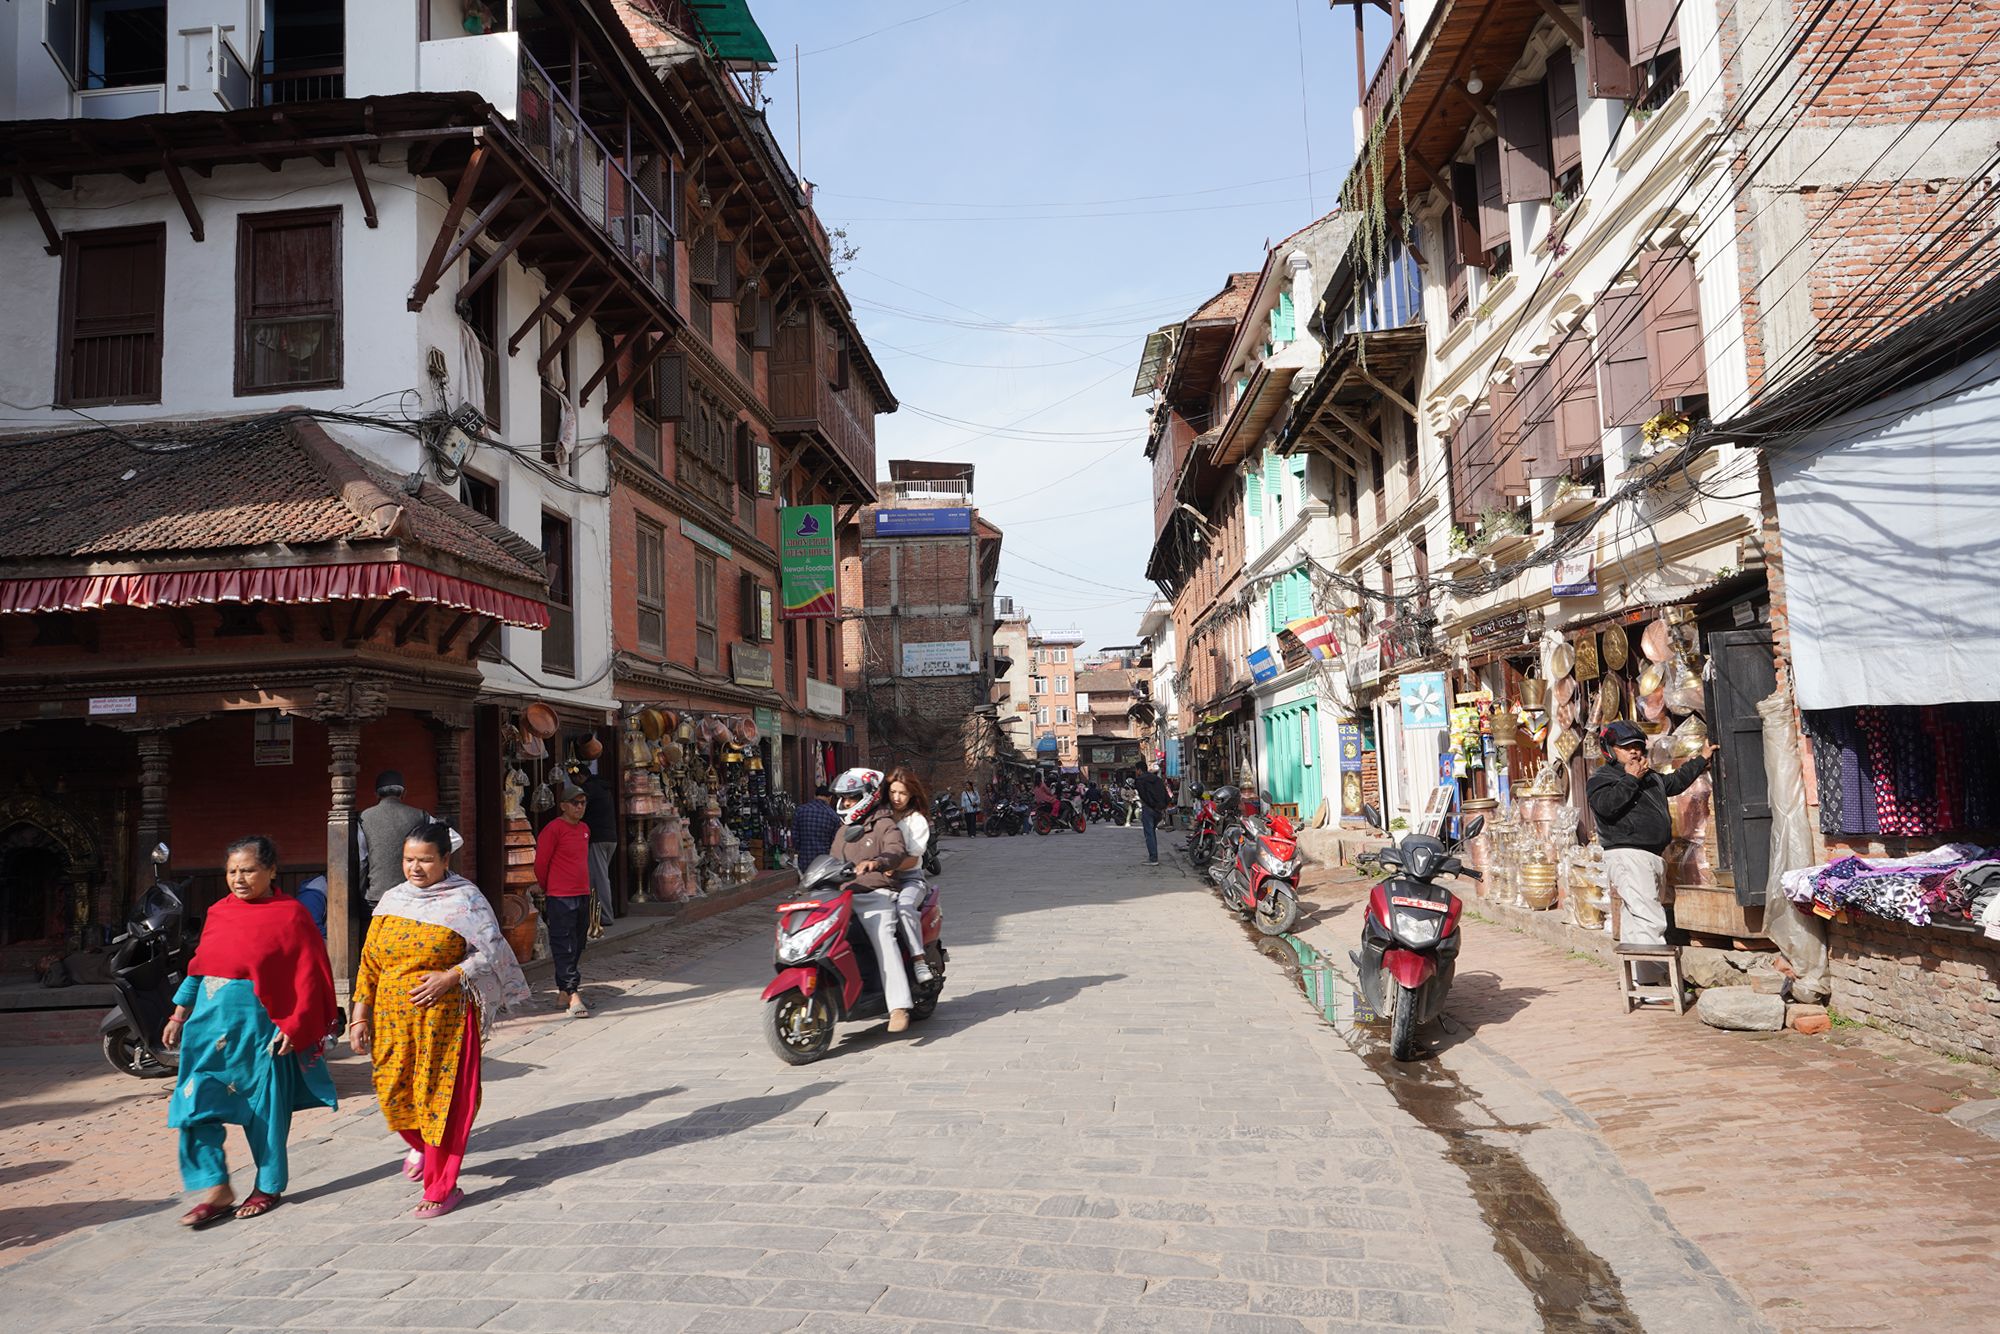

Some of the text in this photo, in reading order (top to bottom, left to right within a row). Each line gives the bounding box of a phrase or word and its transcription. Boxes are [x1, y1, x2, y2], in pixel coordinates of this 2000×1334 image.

[785, 537, 808, 547] MOON
[785, 548, 832, 558] GUEST HOUSE
[805, 564, 833, 572] Foodland
